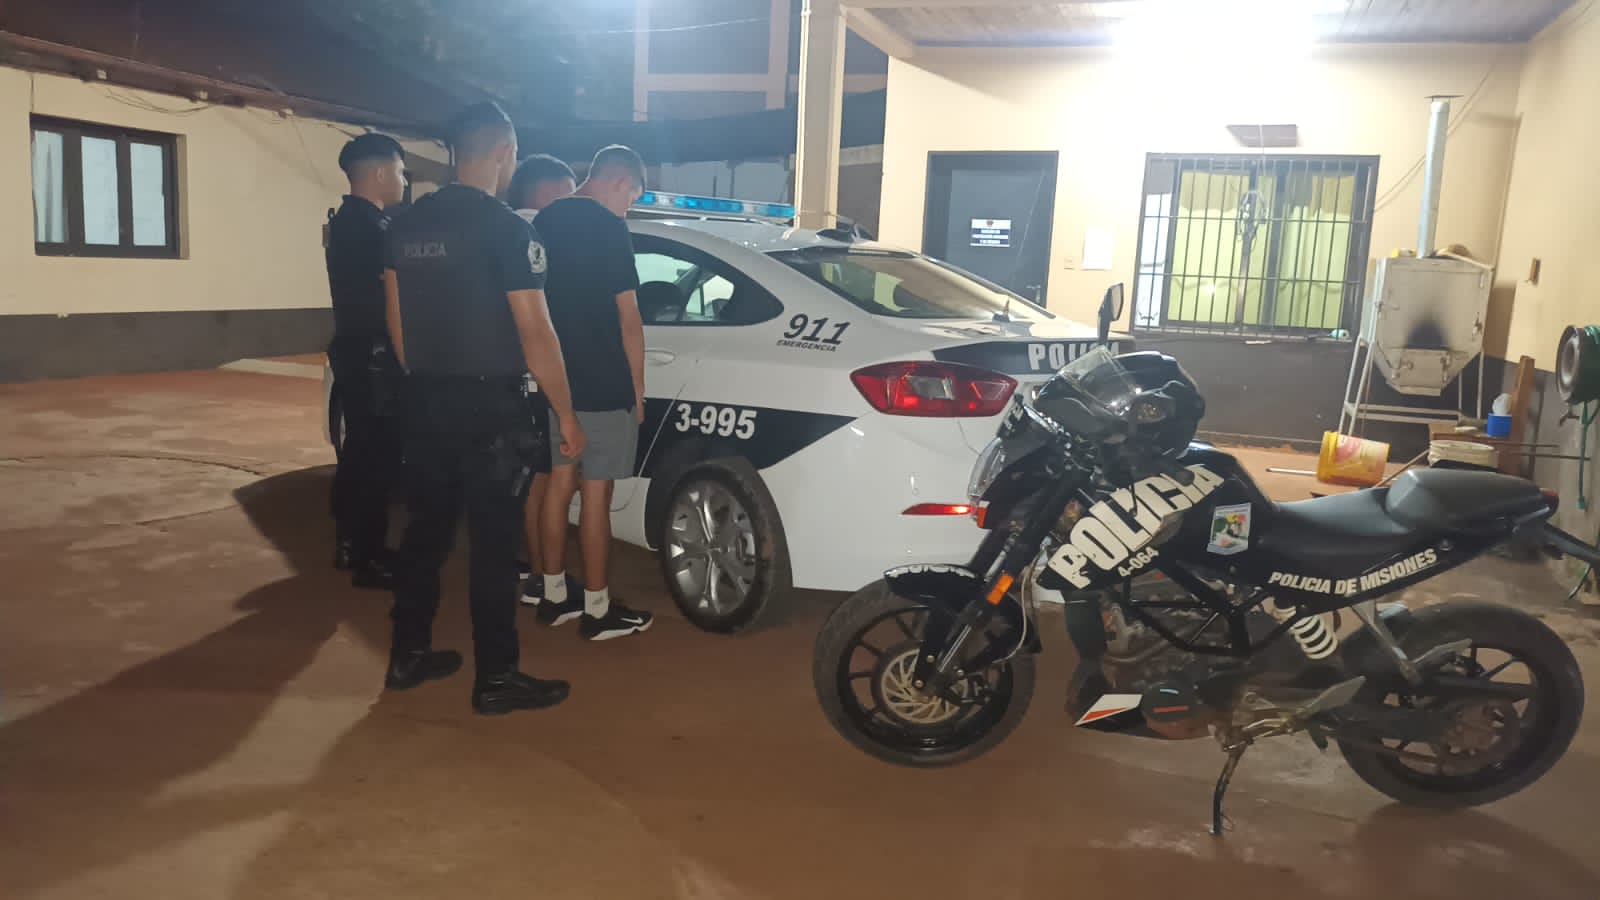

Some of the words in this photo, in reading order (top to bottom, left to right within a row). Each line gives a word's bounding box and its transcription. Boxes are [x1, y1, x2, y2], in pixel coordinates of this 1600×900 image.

[403, 241, 448, 257] POLICIA
[783, 313, 851, 345] 911
[775, 339, 837, 352] EMERGENCIA
[675, 403, 758, 440] 3-995
[1048, 464, 1224, 589] POLICIA
[1118, 546, 1160, 577] 4-064
[1268, 571, 1331, 594] POLICIA
[1334, 577, 1358, 597] DE
[1360, 548, 1438, 591] MISIONES
